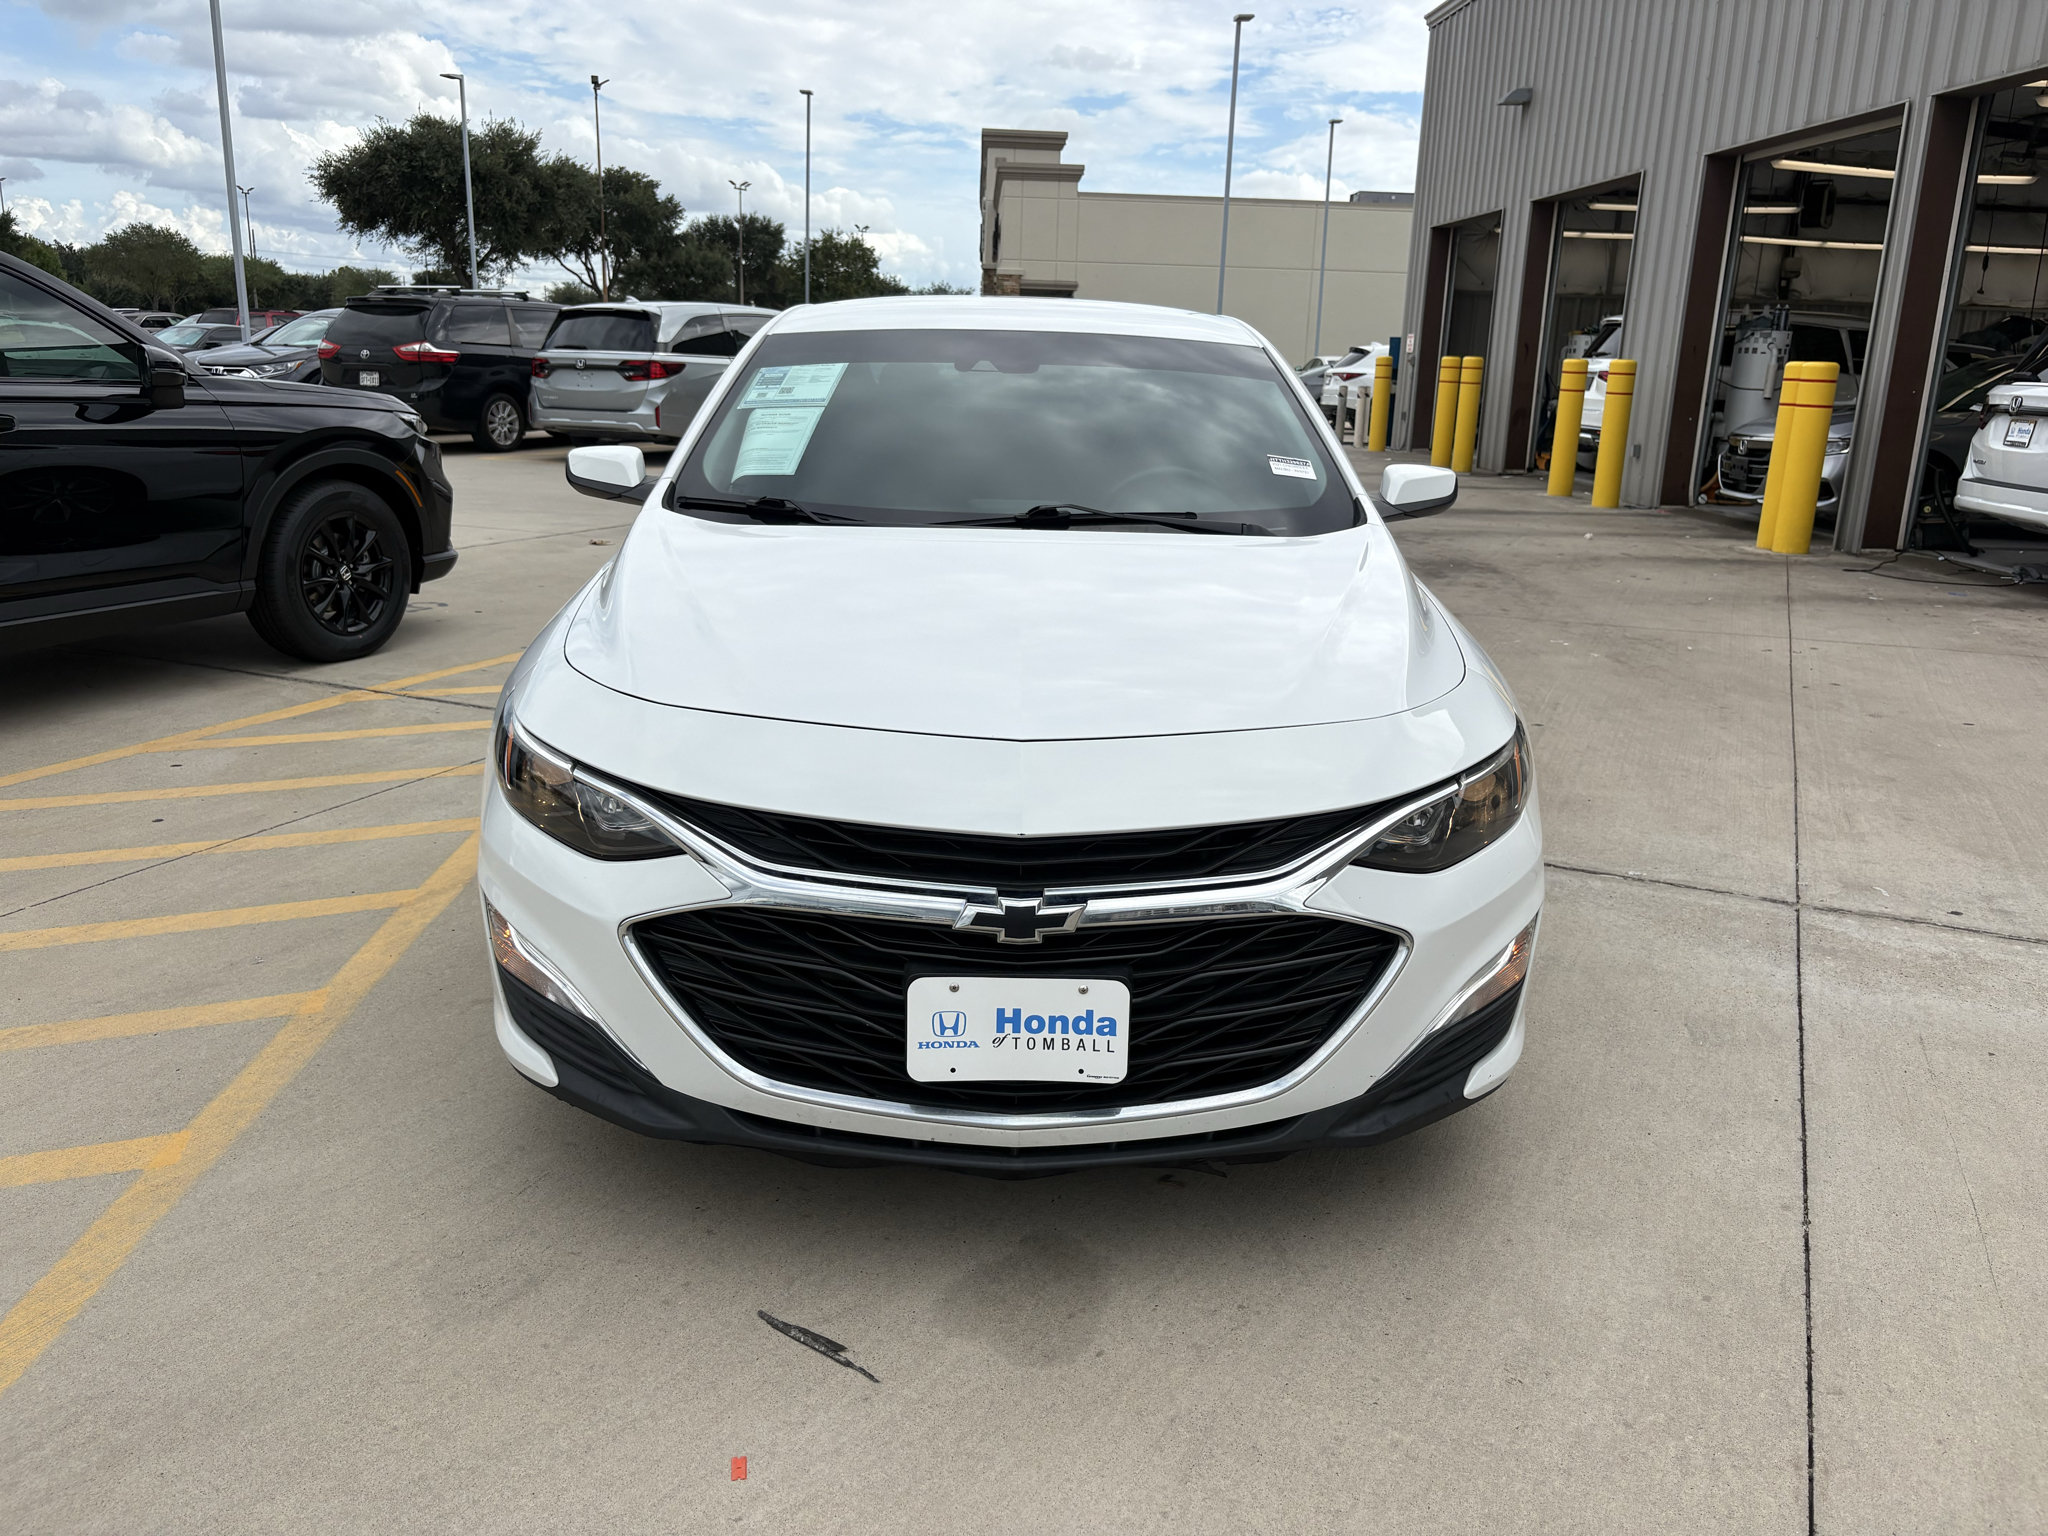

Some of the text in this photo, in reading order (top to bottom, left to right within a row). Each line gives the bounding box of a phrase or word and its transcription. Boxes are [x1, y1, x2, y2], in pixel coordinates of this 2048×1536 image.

[996, 1007, 1118, 1037] Honda
[917, 1040, 980, 1050] HONDA
[992, 1033, 1115, 1053] of TOMBALL
